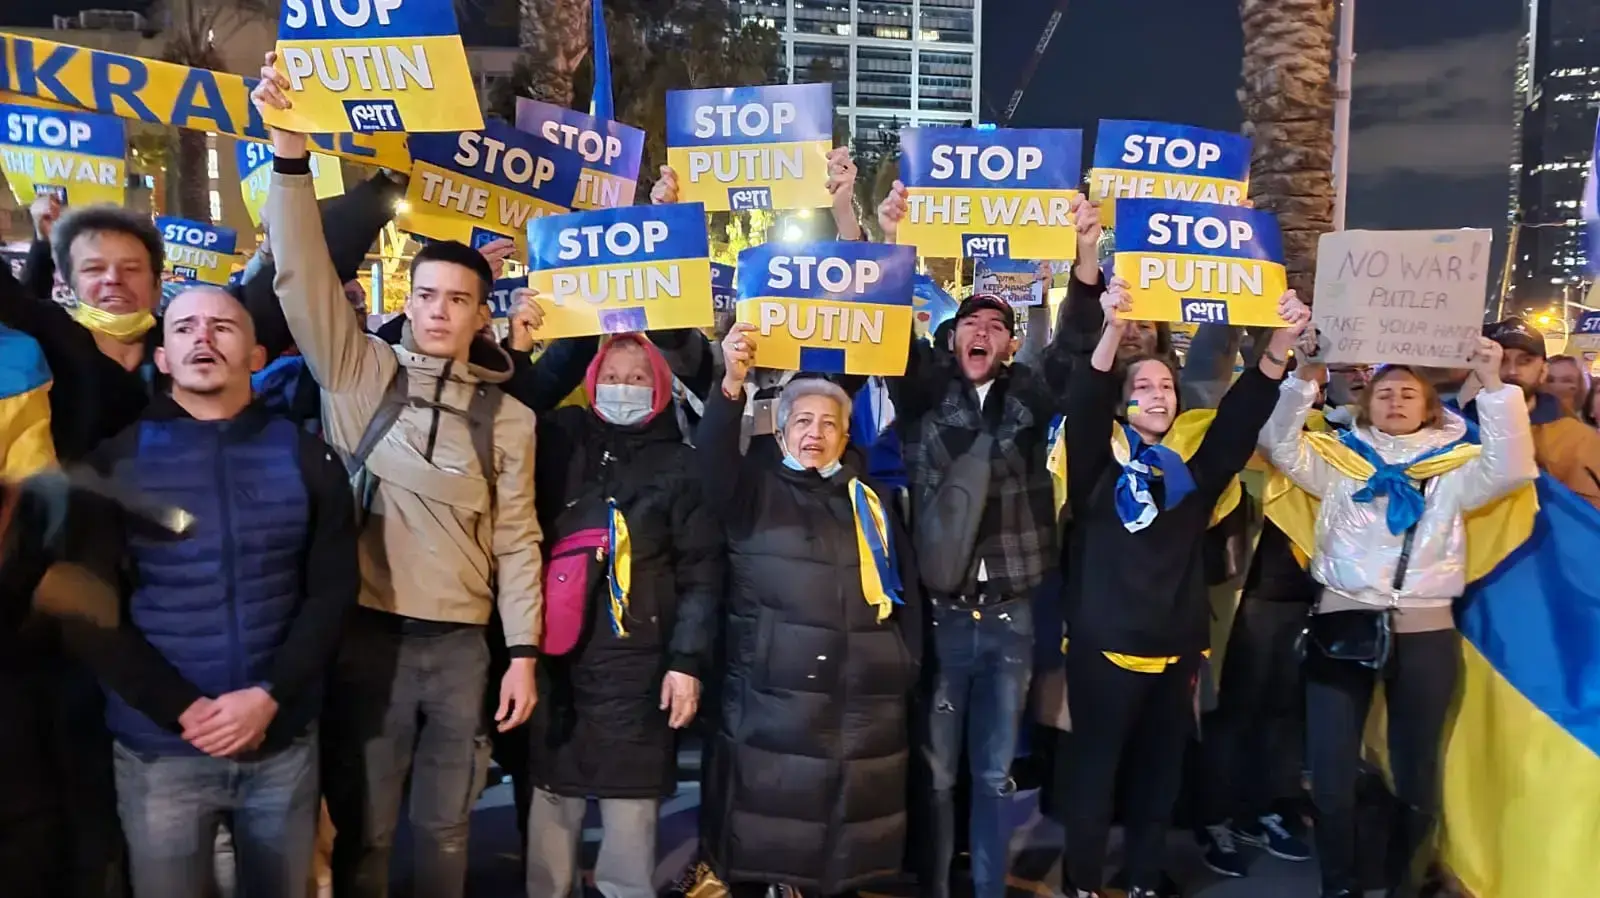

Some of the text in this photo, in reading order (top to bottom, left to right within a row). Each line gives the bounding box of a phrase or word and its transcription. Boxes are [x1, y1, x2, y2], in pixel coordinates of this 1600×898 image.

[286, 0, 402, 28] STOP
[282, 44, 435, 92] PUTIN
[7, 112, 92, 149] STOP
[694, 101, 797, 139] STOP
[454, 130, 555, 190] STOP
[542, 121, 623, 168] STOP
[930, 144, 1043, 181] STOP
[1121, 134, 1221, 170] STOP
[1, 149, 118, 186] THE WAR
[688, 147, 804, 183] PUTIN
[422, 171, 490, 218] THE
[577, 172, 623, 207] TIN
[1098, 174, 1242, 206] THE WAR
[907, 194, 1073, 226] THE WAR
[163, 223, 218, 247] STOP
[558, 221, 669, 260] STOP
[1147, 212, 1254, 250] STOP
[768, 254, 881, 295] STOP
[1138, 256, 1264, 296] PUTIN
[1337, 248, 1390, 281] NO
[551, 264, 682, 307] PUTIN
[1368, 286, 1448, 310] PUTLER
[759, 301, 885, 345] PUTIN
[1321, 314, 1367, 335] TAKE
[1379, 318, 1430, 335] YOUR
